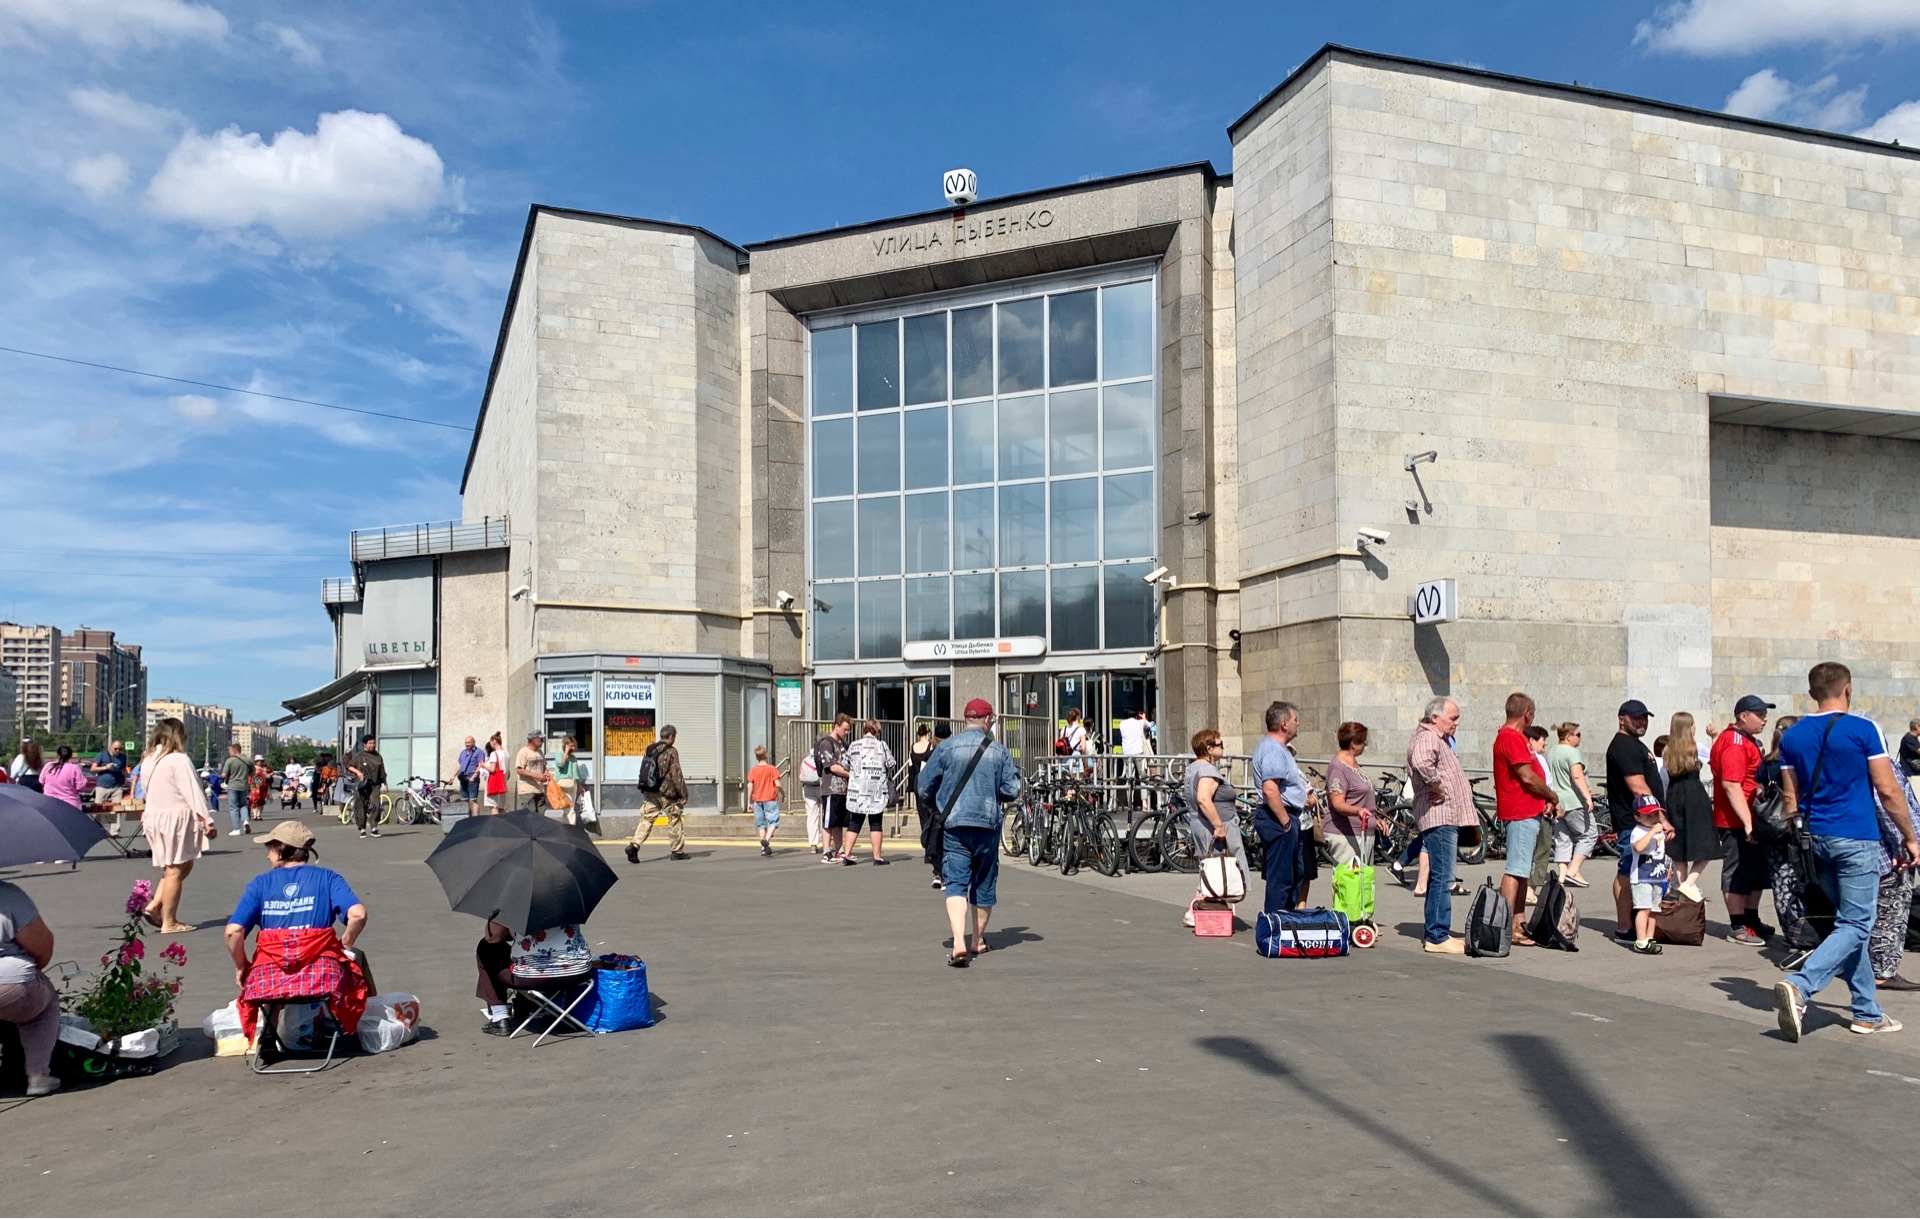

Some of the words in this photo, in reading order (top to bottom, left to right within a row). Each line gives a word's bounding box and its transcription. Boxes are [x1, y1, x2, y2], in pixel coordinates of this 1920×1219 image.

[873, 232, 942, 256] УЛИЦА
[955, 209, 1054, 246] ДЫБЕНКО
[368, 641, 426, 655] ЦВЕТЫ
[552, 689, 590, 700] КЛЮЧЕЙ
[605, 690, 652, 701] КЛЮЧЕЙ
